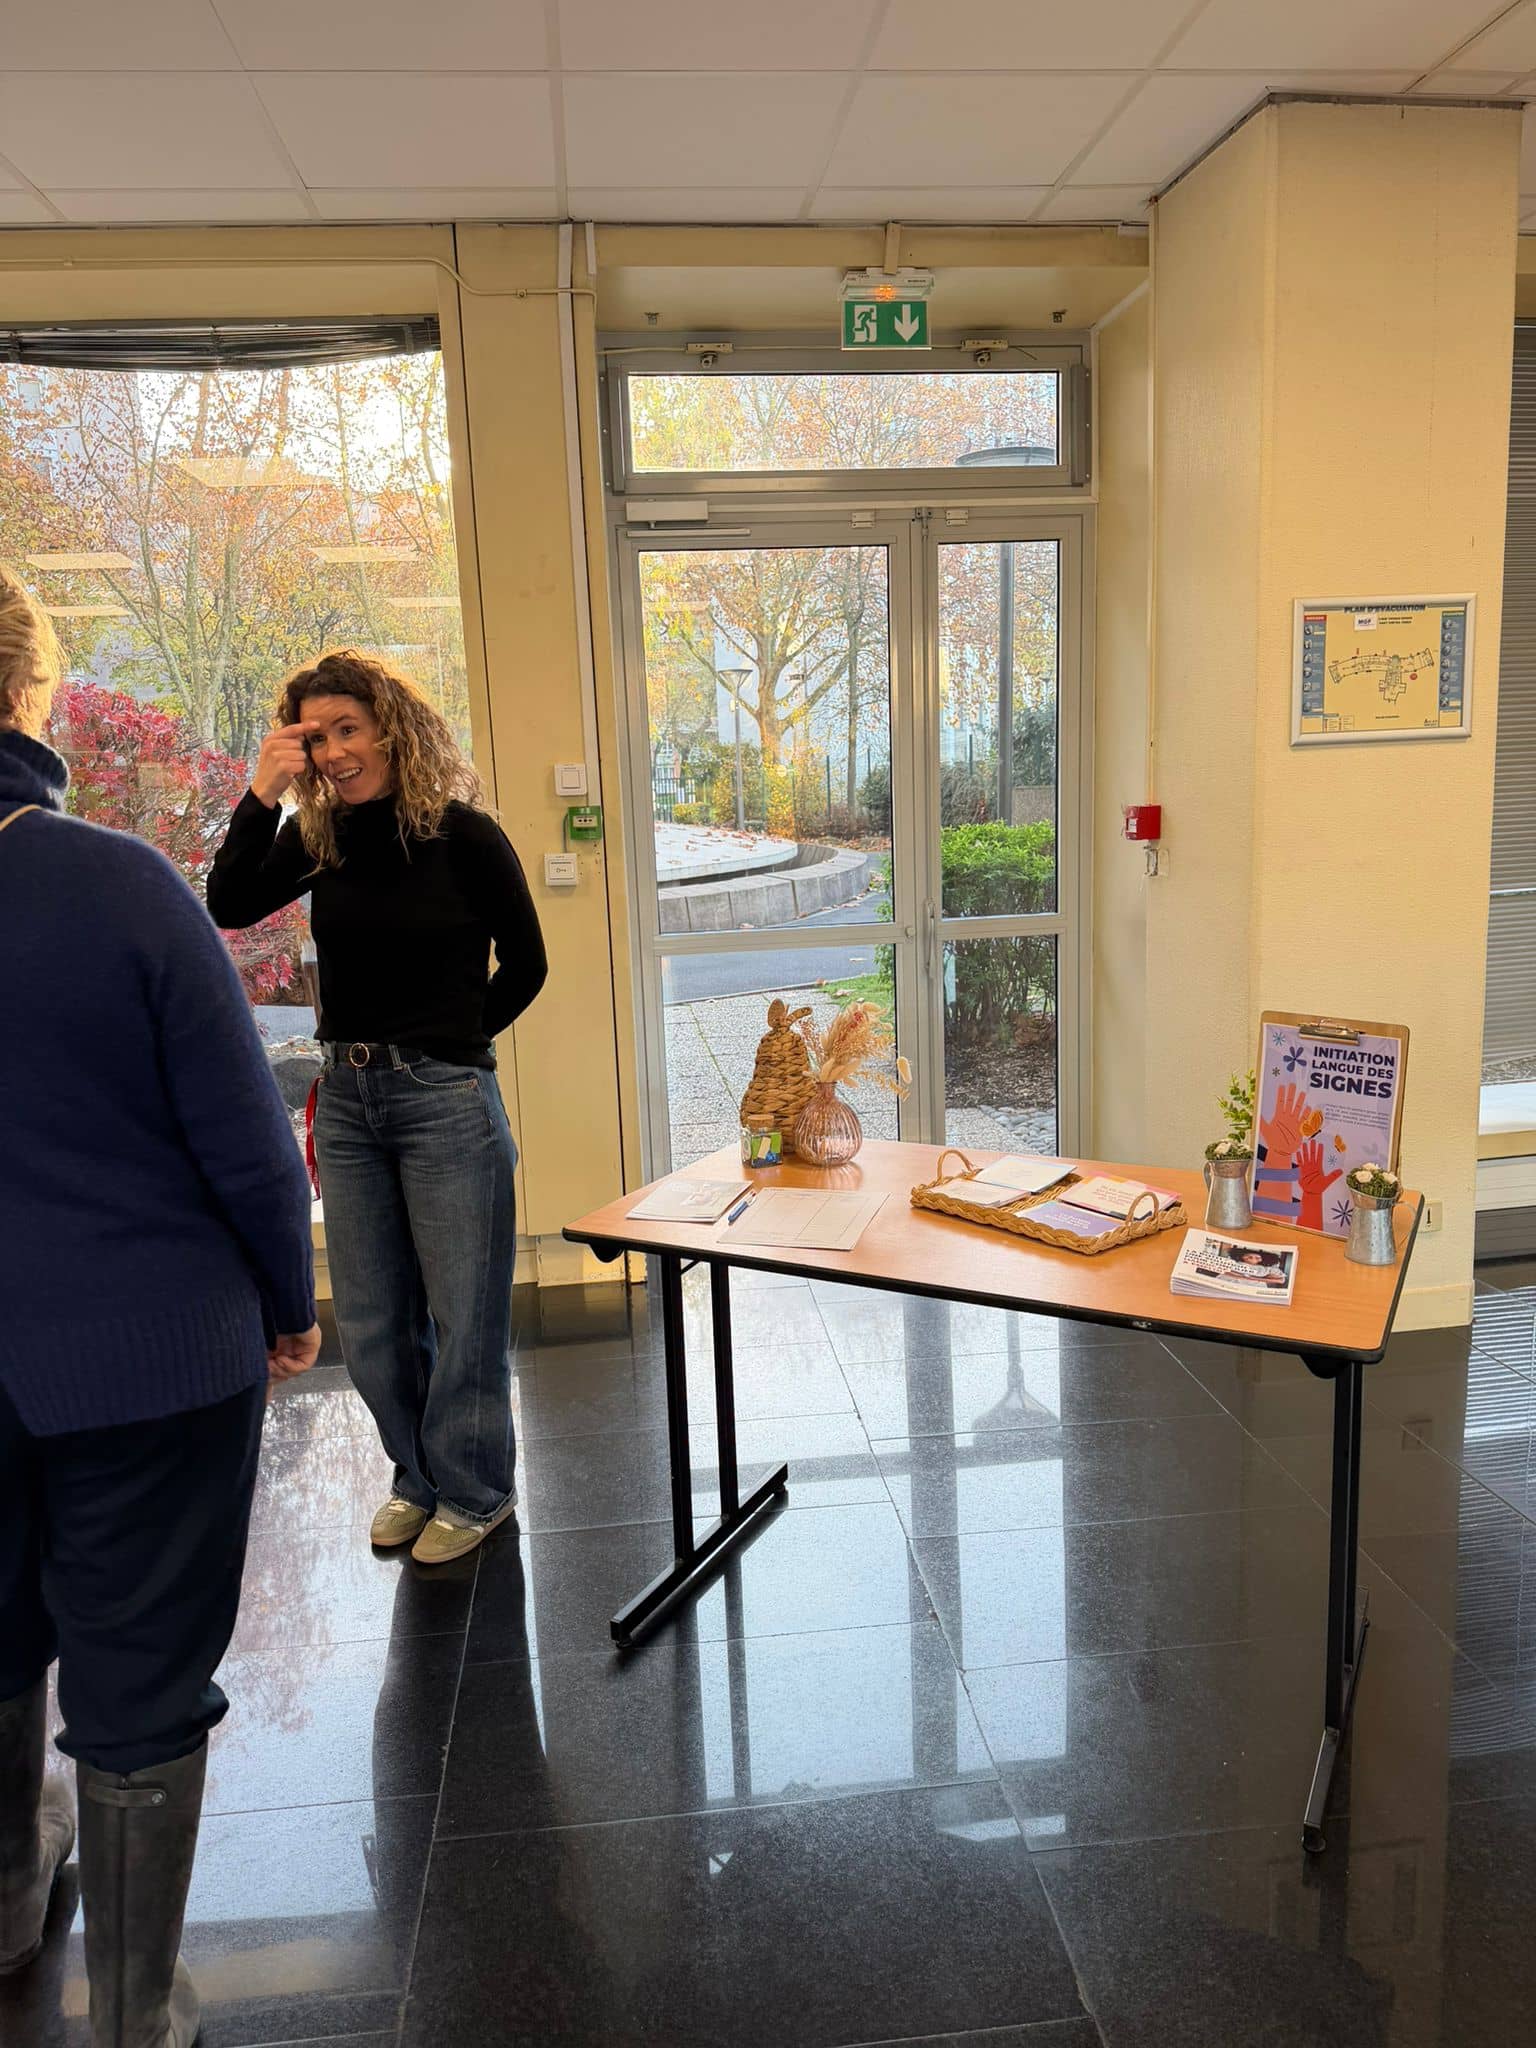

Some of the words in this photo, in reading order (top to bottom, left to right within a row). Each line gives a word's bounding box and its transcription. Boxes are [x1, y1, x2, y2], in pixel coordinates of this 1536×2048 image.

[1344, 605, 1366, 613] PLAN
[1313, 1046, 1395, 1067] INITIATION
[1312, 1059, 1364, 1075] LANGUE
[1367, 1067, 1394, 1079] DES
[1310, 1072, 1392, 1099] SIGNES
